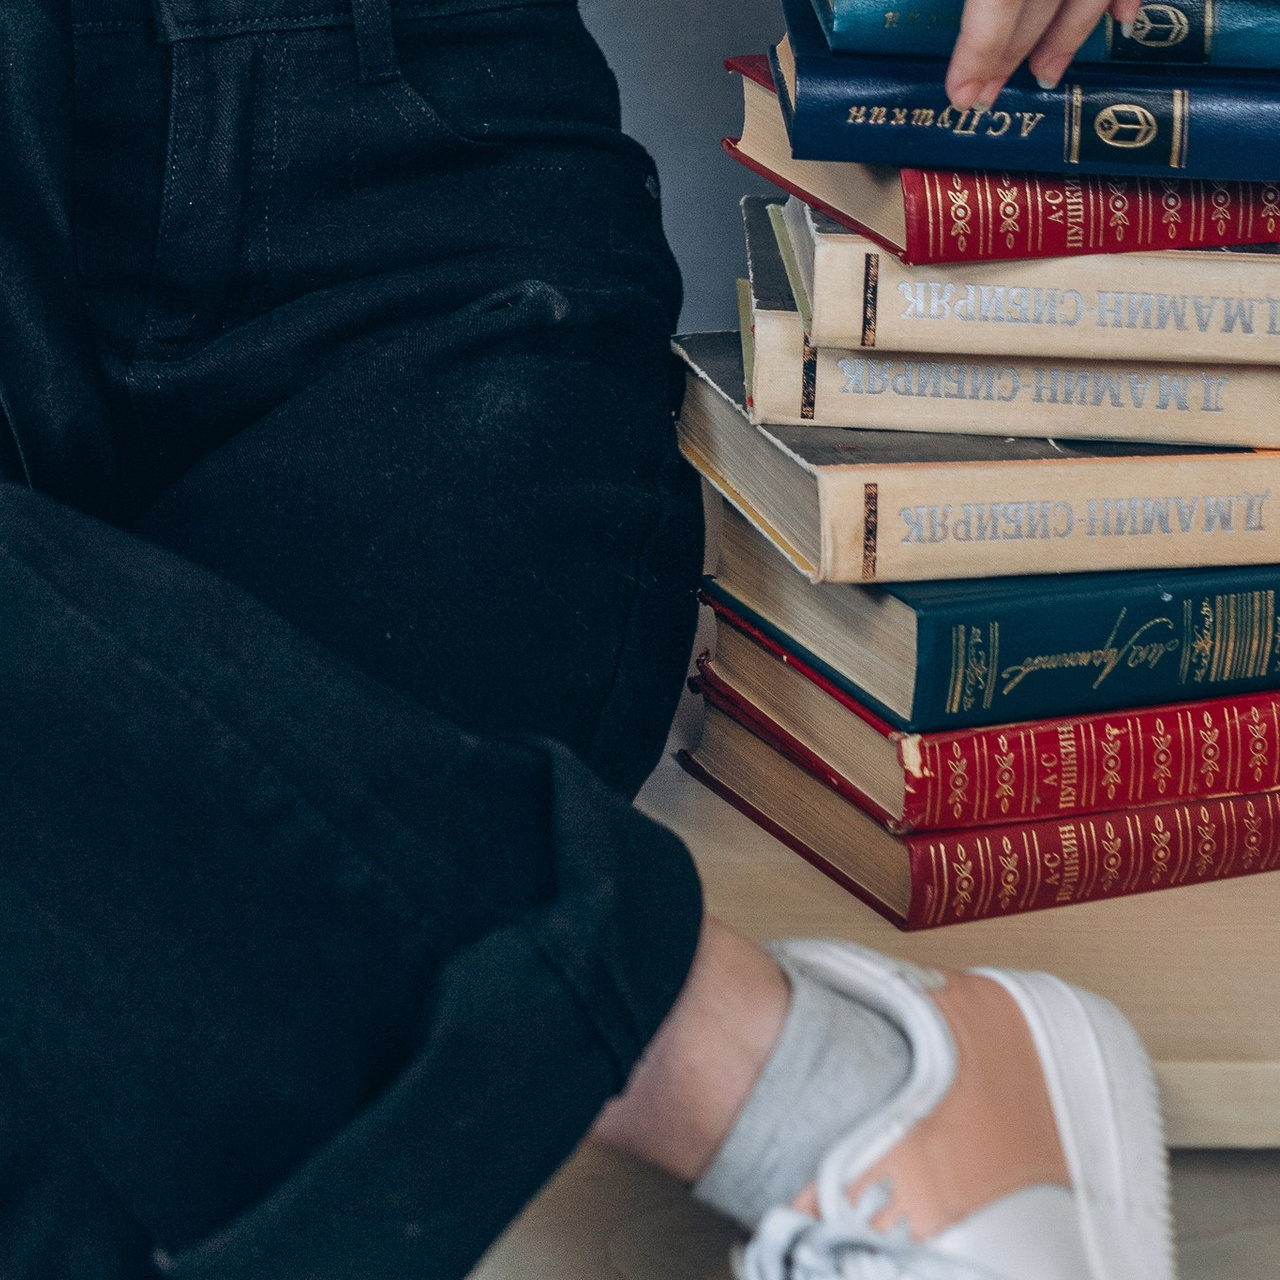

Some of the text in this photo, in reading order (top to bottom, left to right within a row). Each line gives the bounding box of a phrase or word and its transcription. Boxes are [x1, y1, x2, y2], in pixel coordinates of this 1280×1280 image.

[837, 358, 1229, 414] Д.МАМИН-СИБИРЯК
[898, 487, 1270, 546] Д.МАМИН-СИБИРЯК
[1056, 724, 1078, 809] ПУШКИН
[1054, 823, 1080, 903] ПУШКИН
